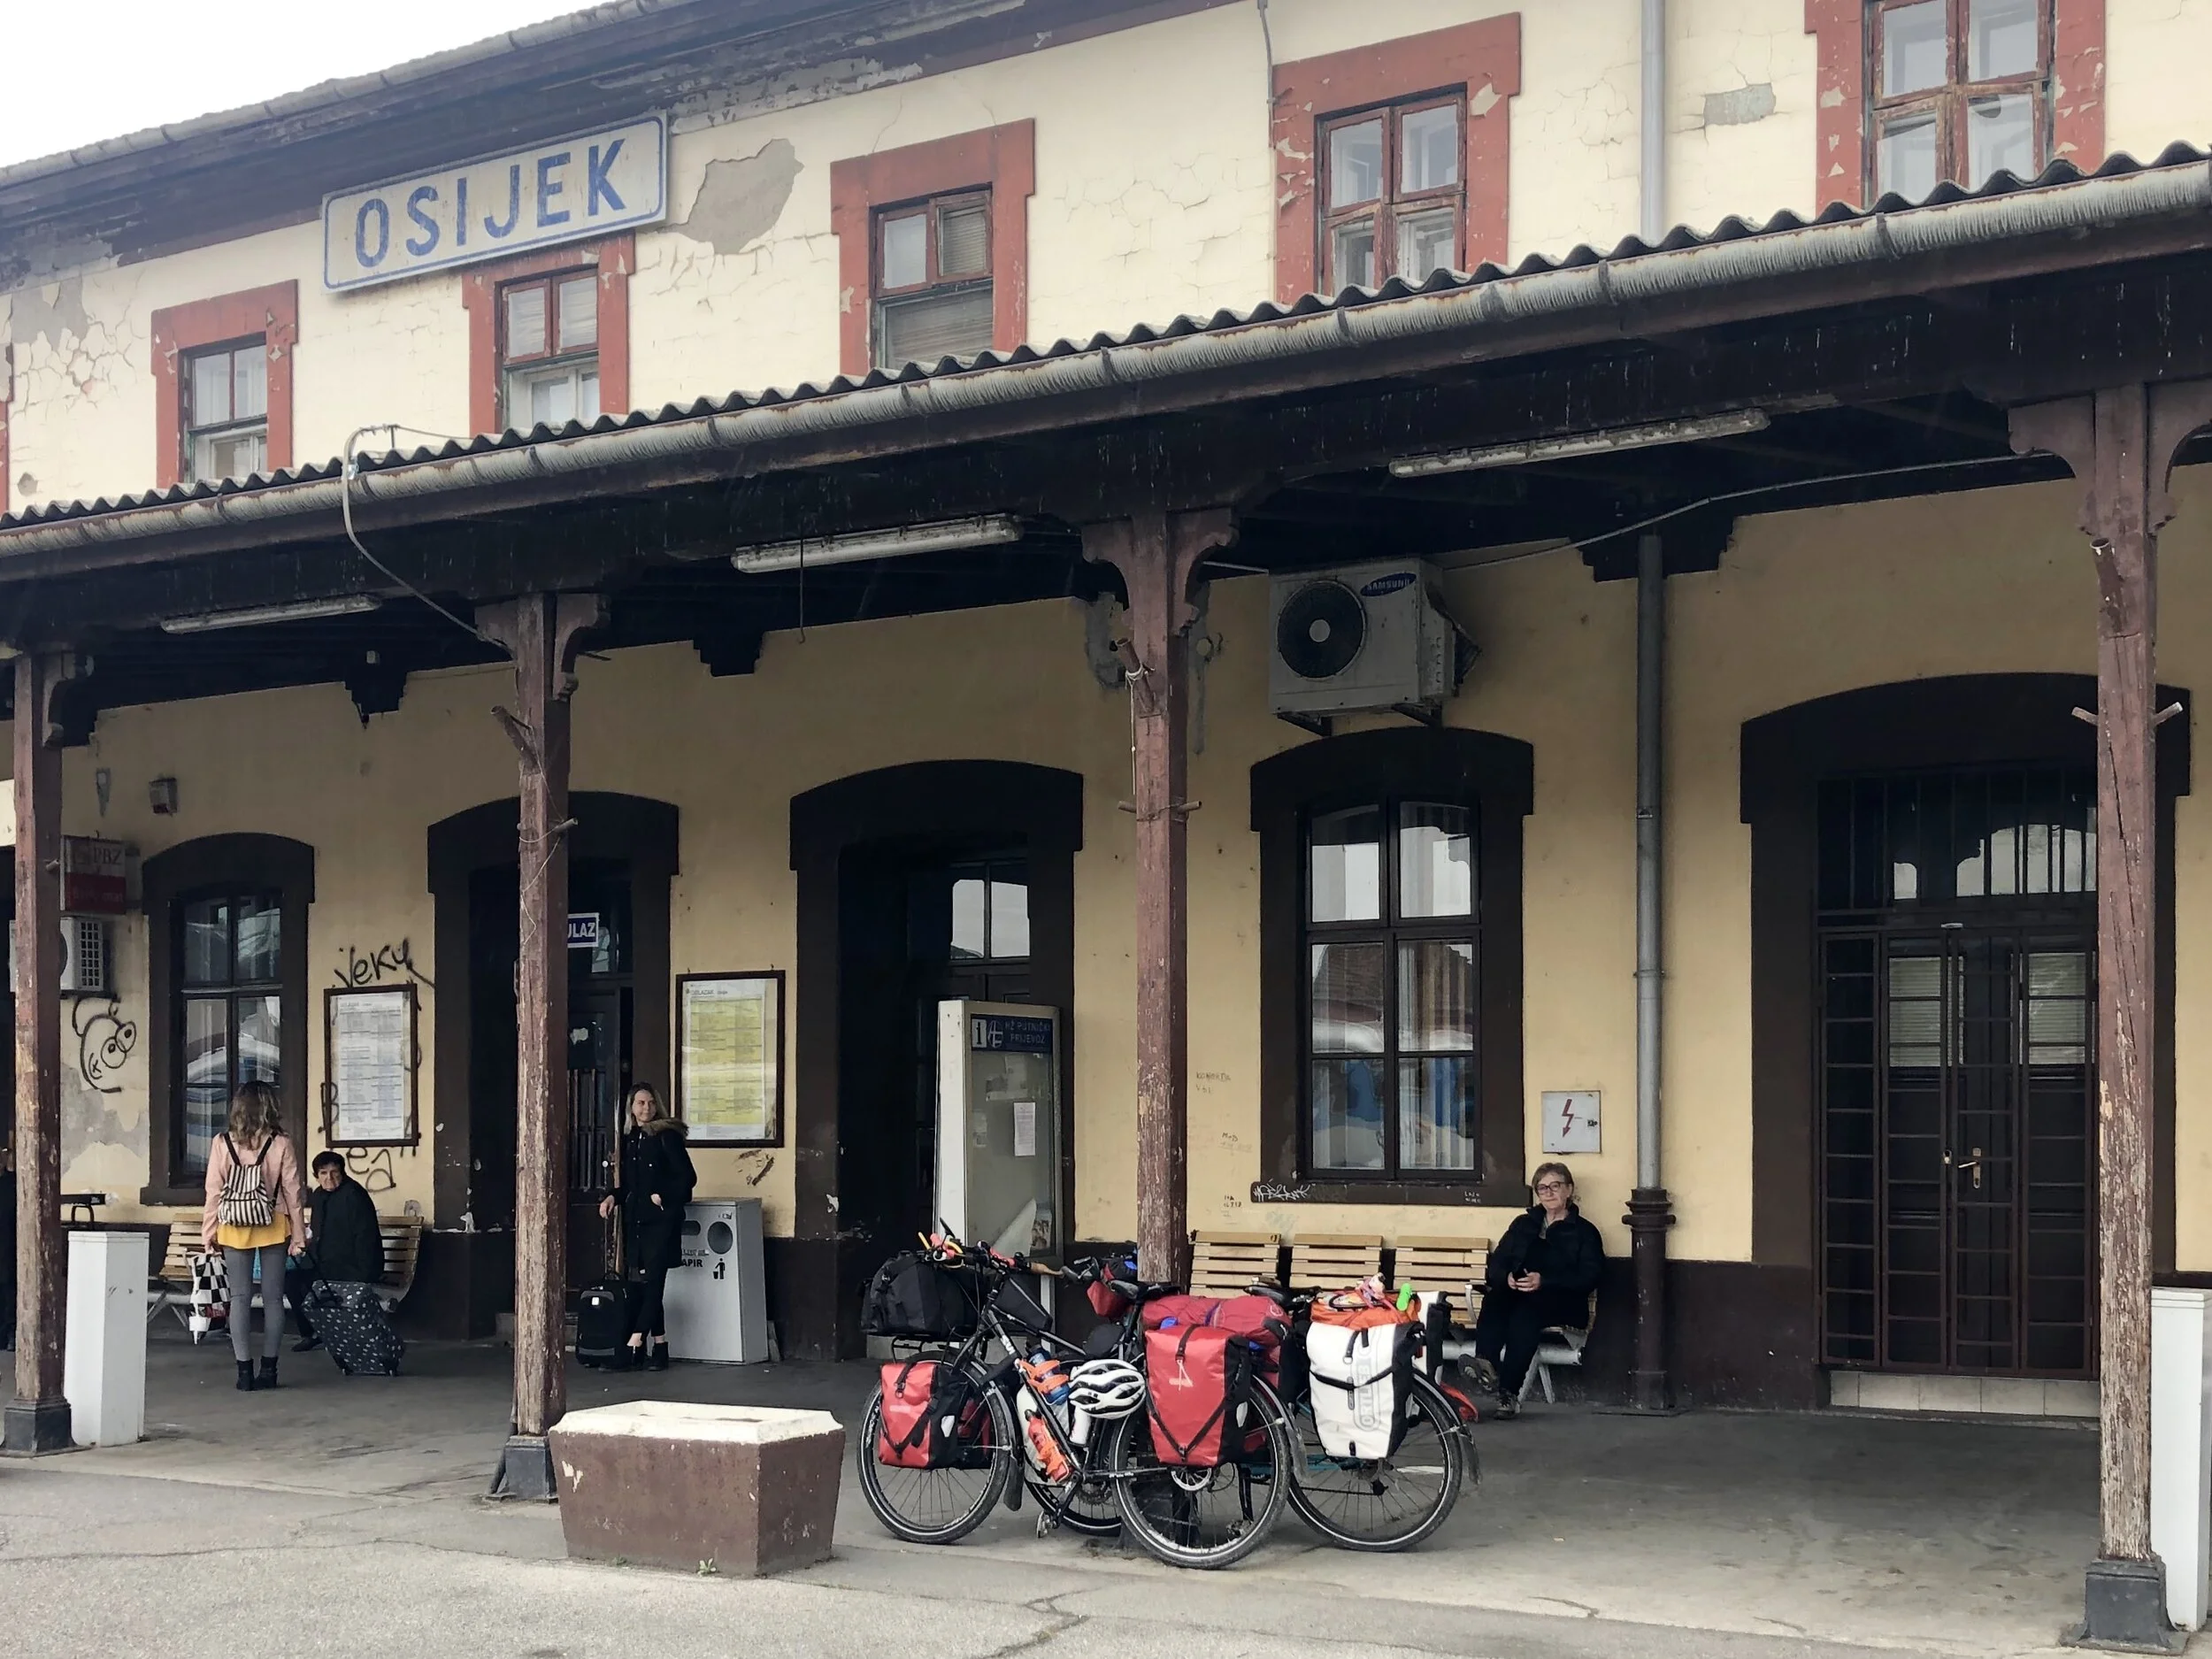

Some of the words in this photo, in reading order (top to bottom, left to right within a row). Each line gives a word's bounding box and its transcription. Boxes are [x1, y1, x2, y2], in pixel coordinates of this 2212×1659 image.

[356, 138, 626, 268] OSIJEK
[93, 847, 122, 865] PBZ
[1010, 1033, 1046, 1044] PRIJEVOZ
